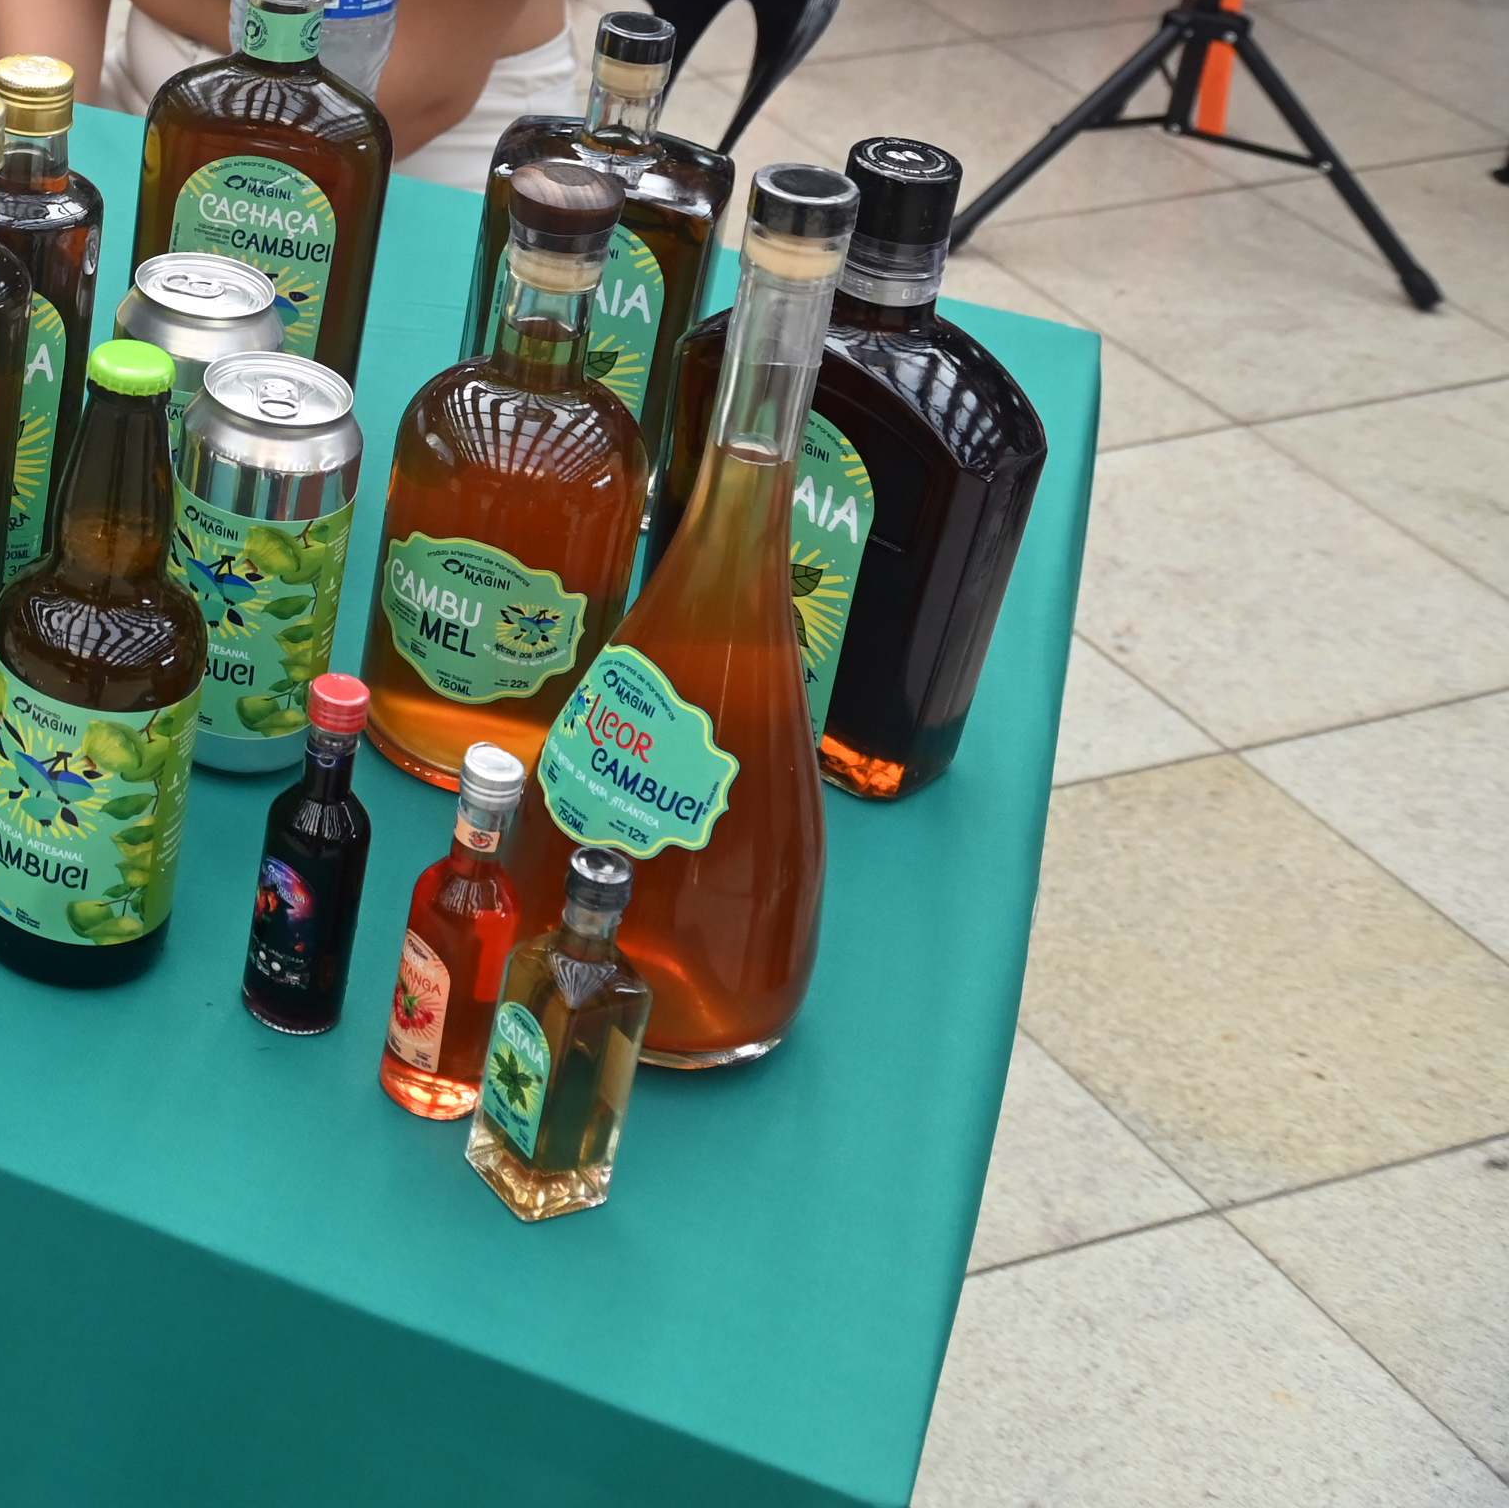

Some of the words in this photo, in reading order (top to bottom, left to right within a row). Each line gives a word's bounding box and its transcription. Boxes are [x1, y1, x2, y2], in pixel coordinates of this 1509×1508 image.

[208, 162, 231, 174] Produto
[247, 183, 291, 200] MAGINI
[199, 193, 318, 239] CACHAÇA
[231, 229, 331, 263] CAMBUCI
[595, 279, 651, 323] AIA
[801, 445, 830, 464] GINI
[815, 423, 850, 459] Parelheiros
[793, 474, 858, 544] AIA
[199, 518, 239, 542] MAGINI
[450, 550, 482, 562] Artesanal
[483, 557, 494, 565] de
[495, 561, 531, 587] Parelheiros
[464, 570, 511, 591] MAGINI
[466, 563, 495, 576] Recanto
[390, 558, 482, 627] CAMBU
[419, 611, 476, 657] MEL
[207, 643, 250, 662] TESANAL
[203, 656, 255, 688] BUCI
[438, 677, 471, 696] 750ML
[510, 680, 529, 688] 22%
[620, 677, 644, 697] Recanto
[33, 703, 61, 720] Recanto
[615, 685, 656, 719] MAGINI
[637, 673, 646, 684] de
[646, 682, 676, 722] Parelheiros
[31, 710, 77, 737] MAGINI
[586, 694, 654, 764] LICOR
[575, 770, 586, 783] DA
[588, 780, 608, 800] MATA
[610, 796, 659, 830] ATLÂNTICA
[591, 748, 704, 825] CAMBUCI
[557, 805, 584, 835] 750ML
[628, 826, 649, 844] 12%
[27, 838, 84, 863] ARTESANAL
[401, 959, 441, 996] ITANGA
[497, 1011, 544, 1072] CATAIA
